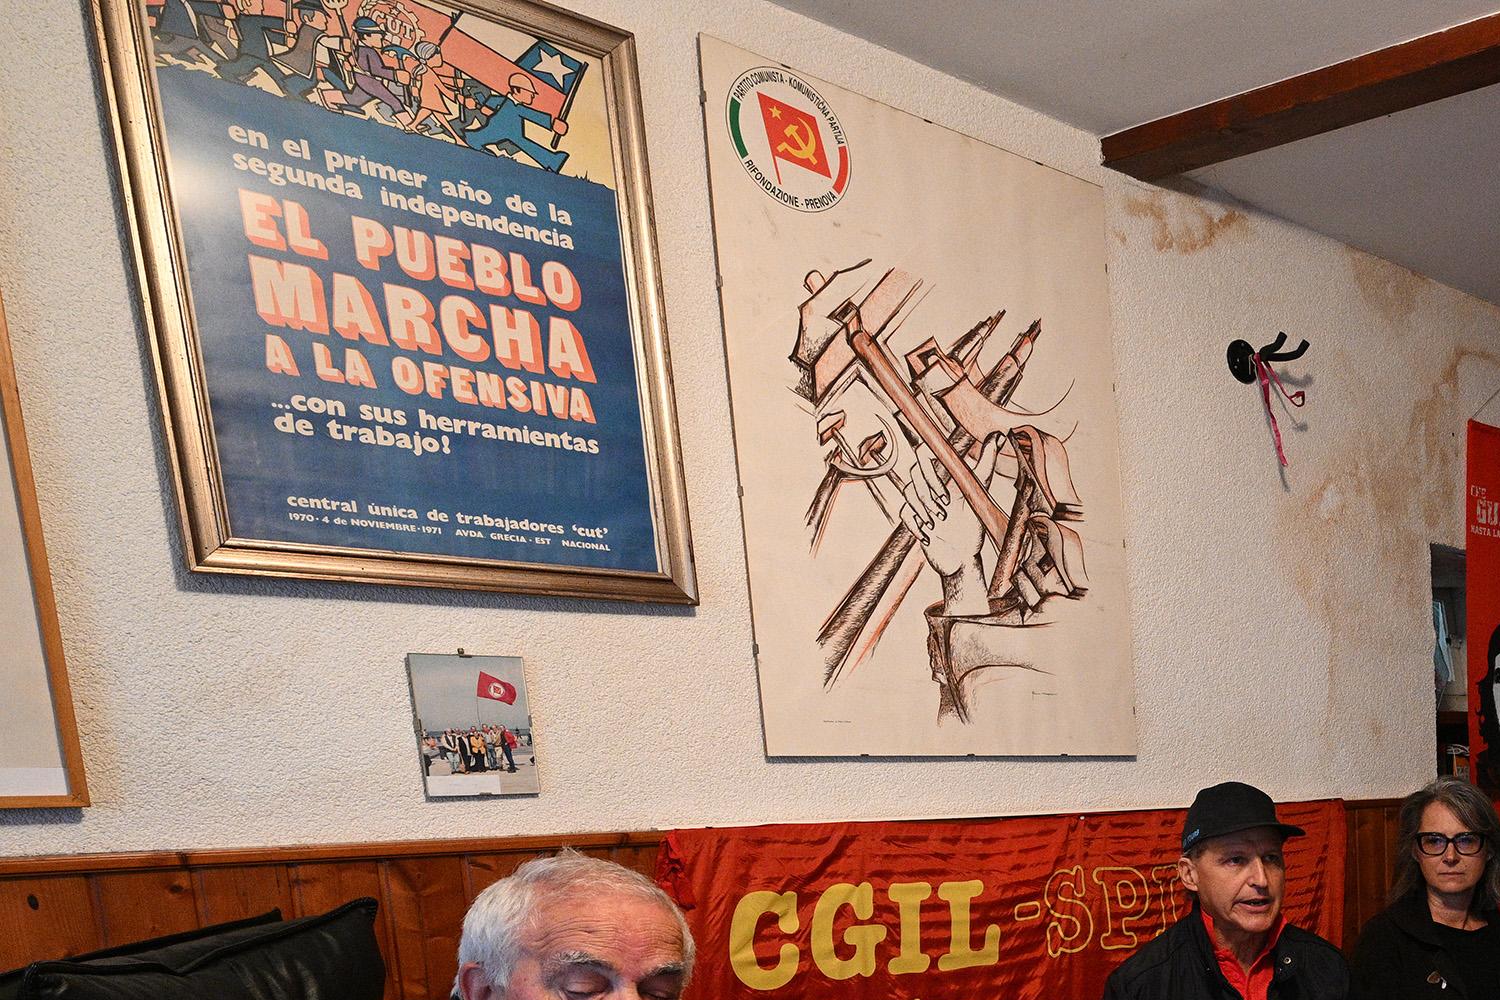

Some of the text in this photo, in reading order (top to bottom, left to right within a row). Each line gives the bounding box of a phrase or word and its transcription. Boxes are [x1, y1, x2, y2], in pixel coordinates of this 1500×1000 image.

[371, 9, 414, 40] CUT
[733, 77, 752, 100] PARTITO
[750, 71, 785, 89] COMUNISTA
[228, 124, 573, 226] en el primer año de la
[744, 159, 838, 209] RIFONDAZIONE PRENOVA
[232, 152, 575, 251] segunda independencia
[238, 187, 582, 312] EL PUEBLO
[248, 253, 597, 384] MARCHA
[265, 334, 598, 425] A LA OFENSIVA
[271, 394, 600, 455] ...con sus herramientas
[274, 413, 450, 458] de trabajo!
[287, 496, 358, 515] central
[367, 501, 418, 520] única
[427, 509, 449, 522] de
[456, 511, 565, 537] trabajadores
[322, 516, 330, 524] 4
[334, 517, 348, 526] de
[1470, 524, 1491, 536] HASTA
[1492, 527, 1500, 538] LA
[490, 532, 527, 543] GRECIA
[562, 539, 611, 552] NACIONAL
